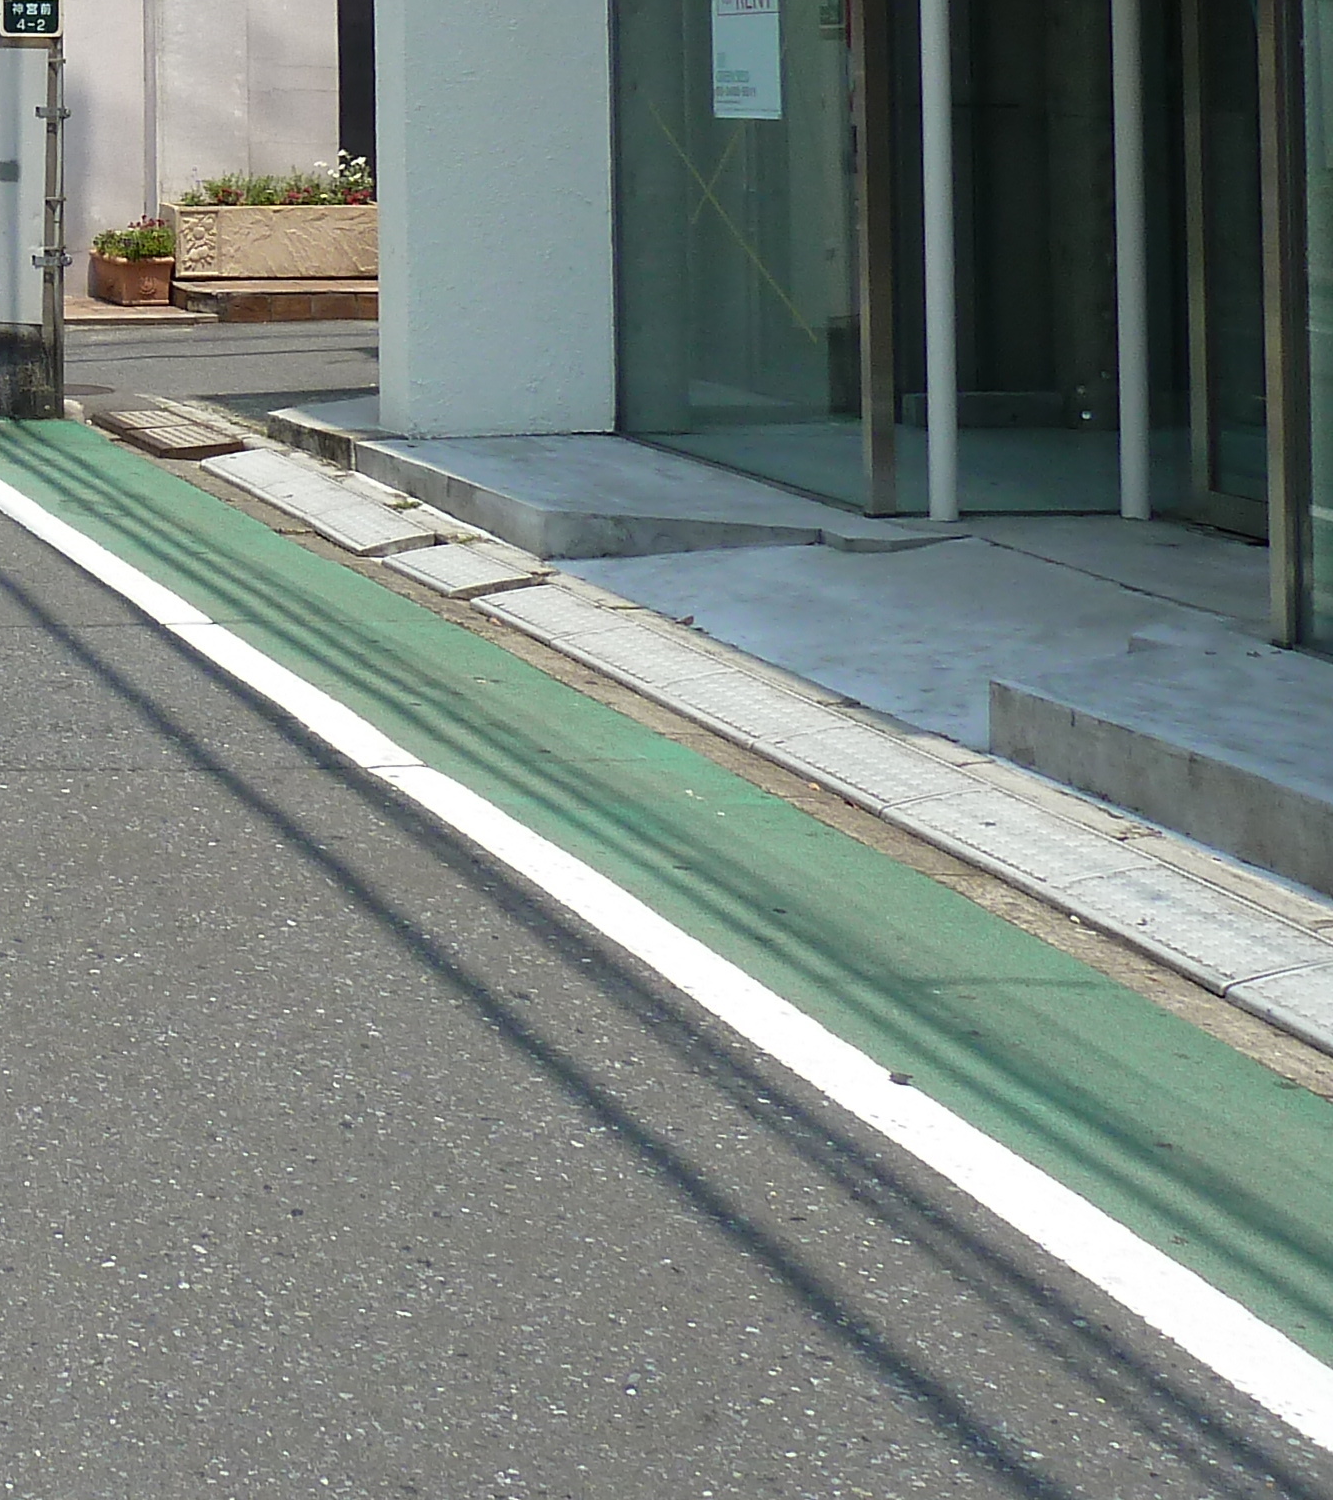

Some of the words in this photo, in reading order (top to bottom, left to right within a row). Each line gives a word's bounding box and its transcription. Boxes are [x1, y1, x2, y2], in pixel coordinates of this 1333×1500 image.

[12, 3, 52, 16] 神宮前
[16, 19, 46, 31] 4-2
